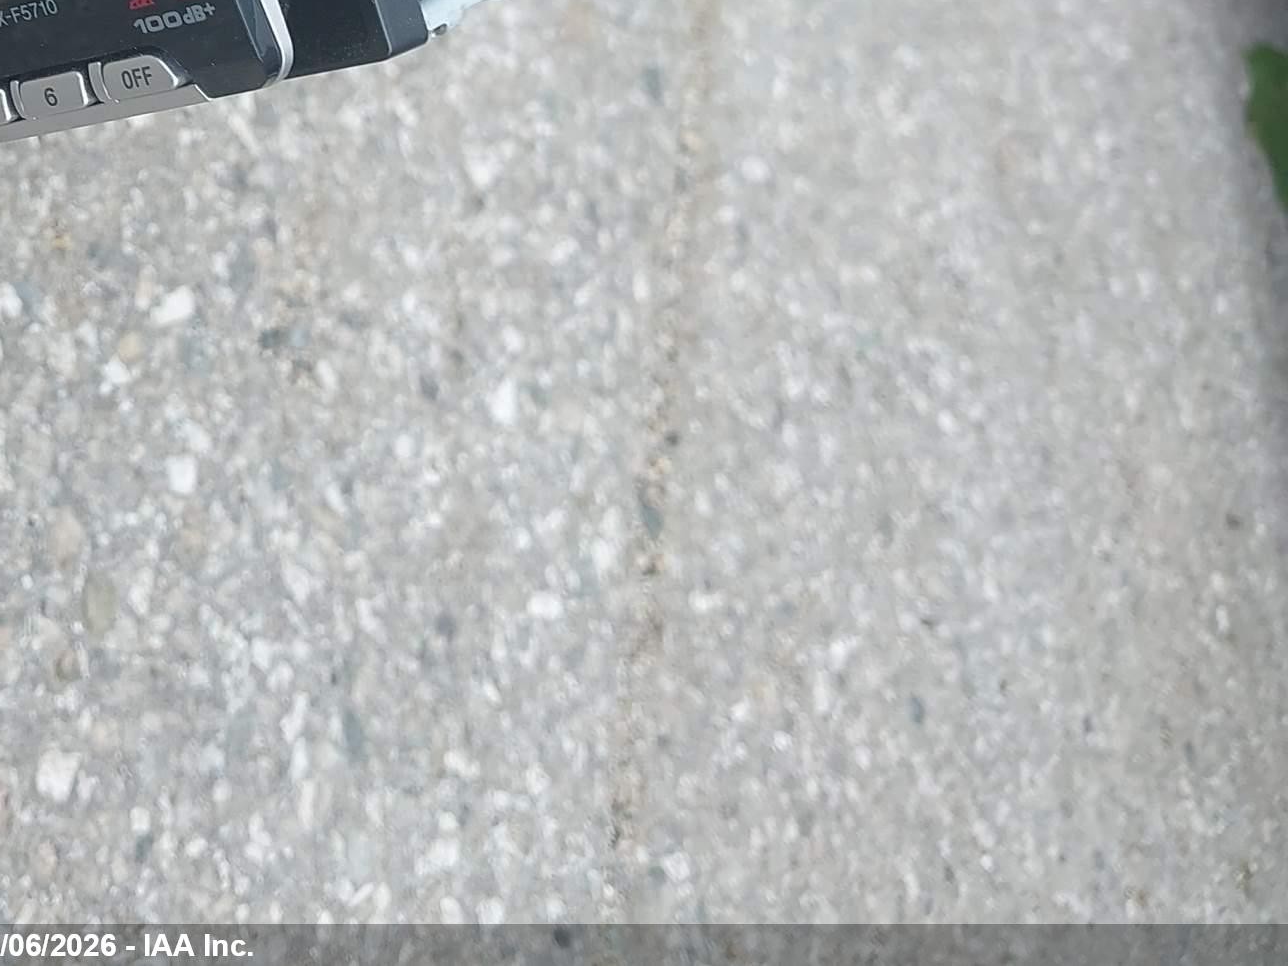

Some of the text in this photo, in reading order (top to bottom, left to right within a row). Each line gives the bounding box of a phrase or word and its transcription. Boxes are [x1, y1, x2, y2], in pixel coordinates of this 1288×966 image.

[133, 2, 216, 34] 100dB+
[121, 65, 153, 90] OFF
[44, 87, 58, 107] 6
